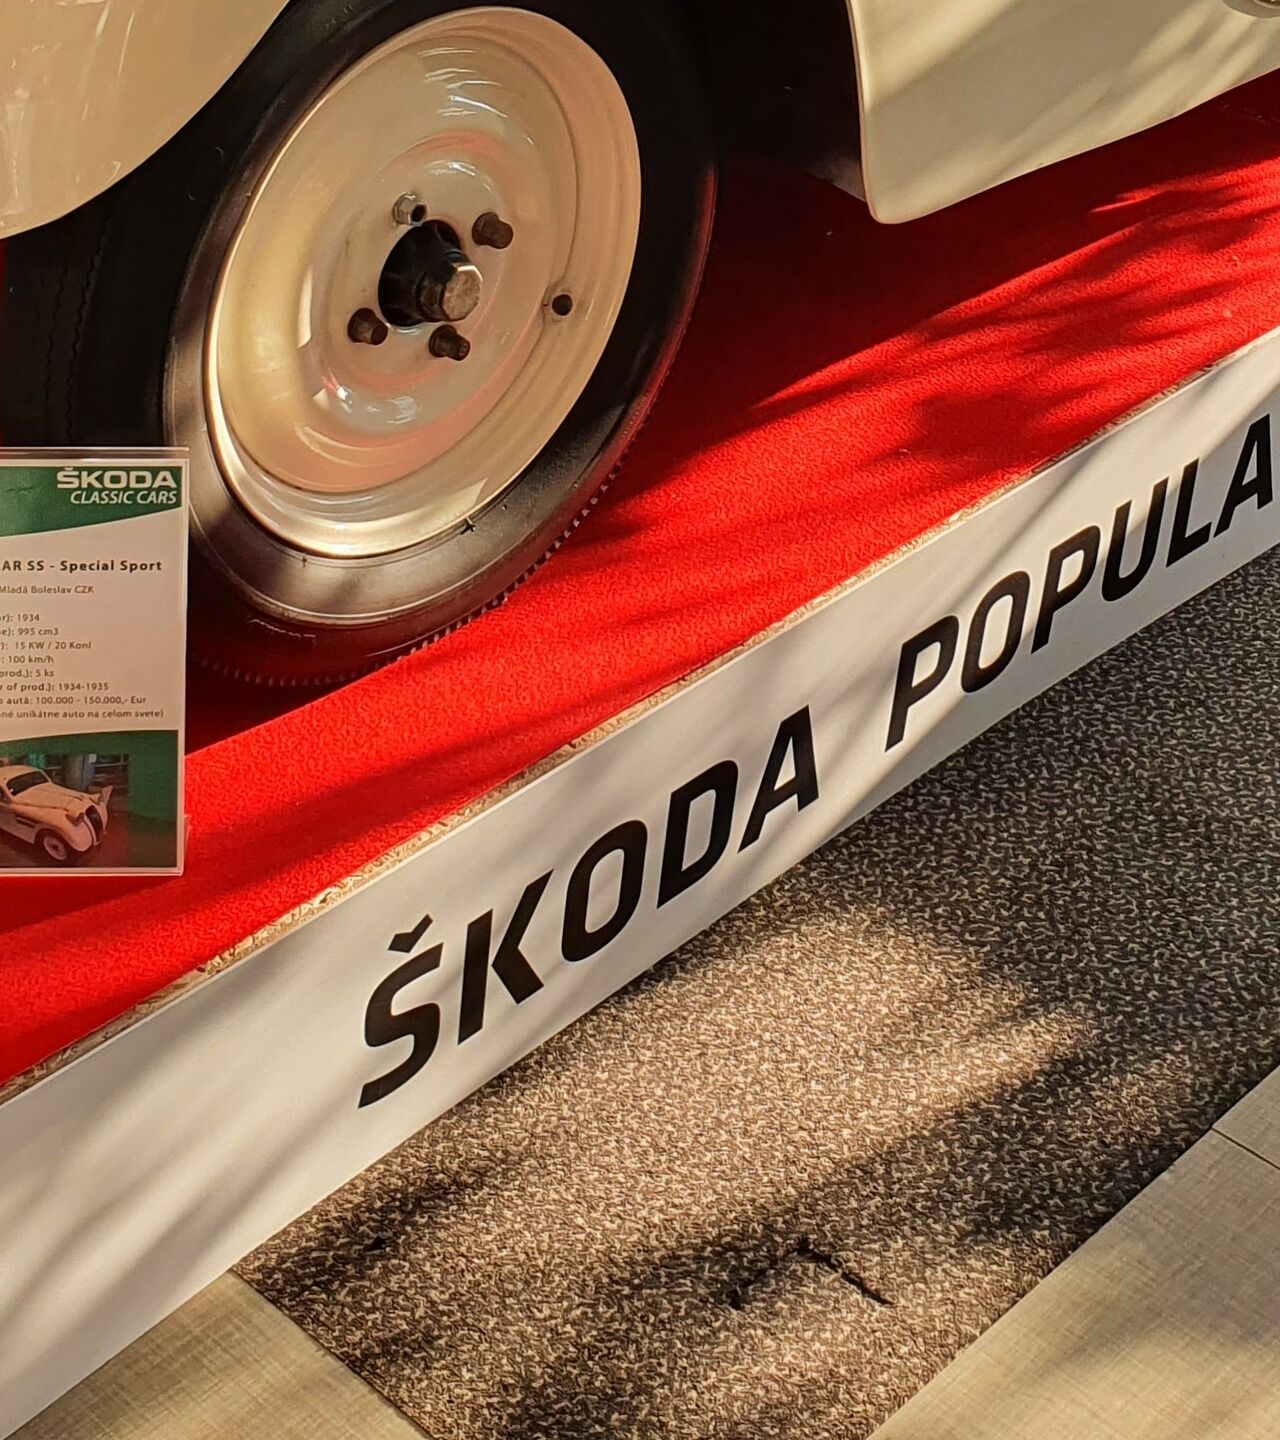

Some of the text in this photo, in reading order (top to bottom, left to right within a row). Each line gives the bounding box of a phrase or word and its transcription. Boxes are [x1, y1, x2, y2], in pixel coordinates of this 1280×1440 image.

[56, 466, 177, 489] ŠKODA
[70, 490, 177, 504] CLASSIC CARS
[27, 560, 45, 571] SS
[60, 560, 114, 573] Special
[120, 560, 162, 573] Sport
[31, 585, 72, 594] Boleslav
[74, 585, 94, 594] CZK
[17, 613, 40, 622] 1934
[17, 627, 36, 636] 995
[38, 627, 59, 636] cm3
[15, 641, 26, 650] 15
[28, 641, 45, 650] KW
[54, 641, 67, 650] 20
[8, 655, 26, 664] 100
[28, 655, 55, 664] km/h
[35, 669, 41, 678] 5
[44, 669, 55, 678] ks
[6, 682, 18, 692] of
[58, 682, 109, 692] 1934-1935
[36, 696, 74, 705] 100.000
[130, 696, 147, 705] Eur
[62, 710, 86, 719] auto
[87, 711, 100, 719] na
[102, 709, 133, 719] celom
[134, 709, 164, 719] svete)
[357, 704, 820, 1109] ŠKODA
